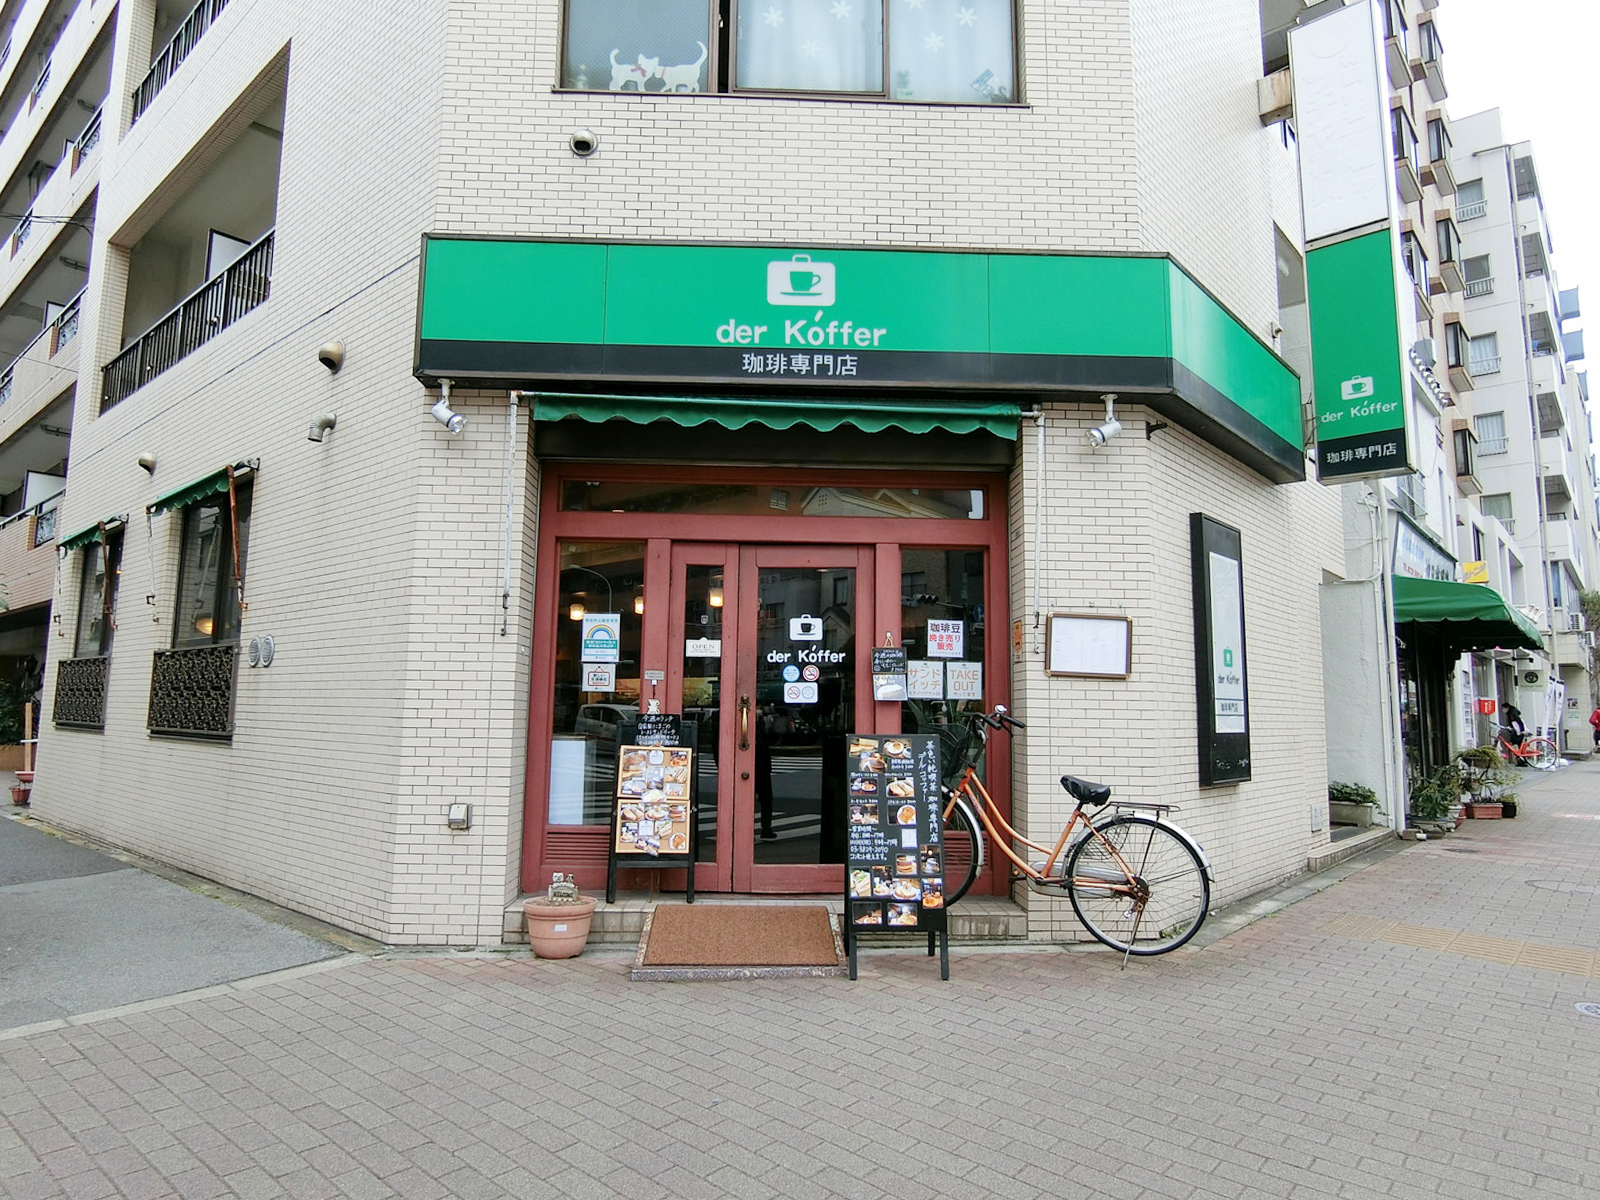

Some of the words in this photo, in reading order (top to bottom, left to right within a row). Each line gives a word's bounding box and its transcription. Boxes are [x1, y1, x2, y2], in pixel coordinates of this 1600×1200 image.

[715, 318, 768, 345] der
[742, 352, 858, 377] 珈琲専門店
[1320, 411, 1344, 423] der
[1326, 442, 1397, 464] 珈琲専門店
[930, 622, 961, 633] 珈琲豆
[937, 642, 954, 651] 販売
[767, 649, 791, 663] der
[908, 668, 941, 679] サンド
[950, 669, 979, 681] TAKE
[909, 679, 941, 690] イッチ
[953, 681, 976, 691] OUT
